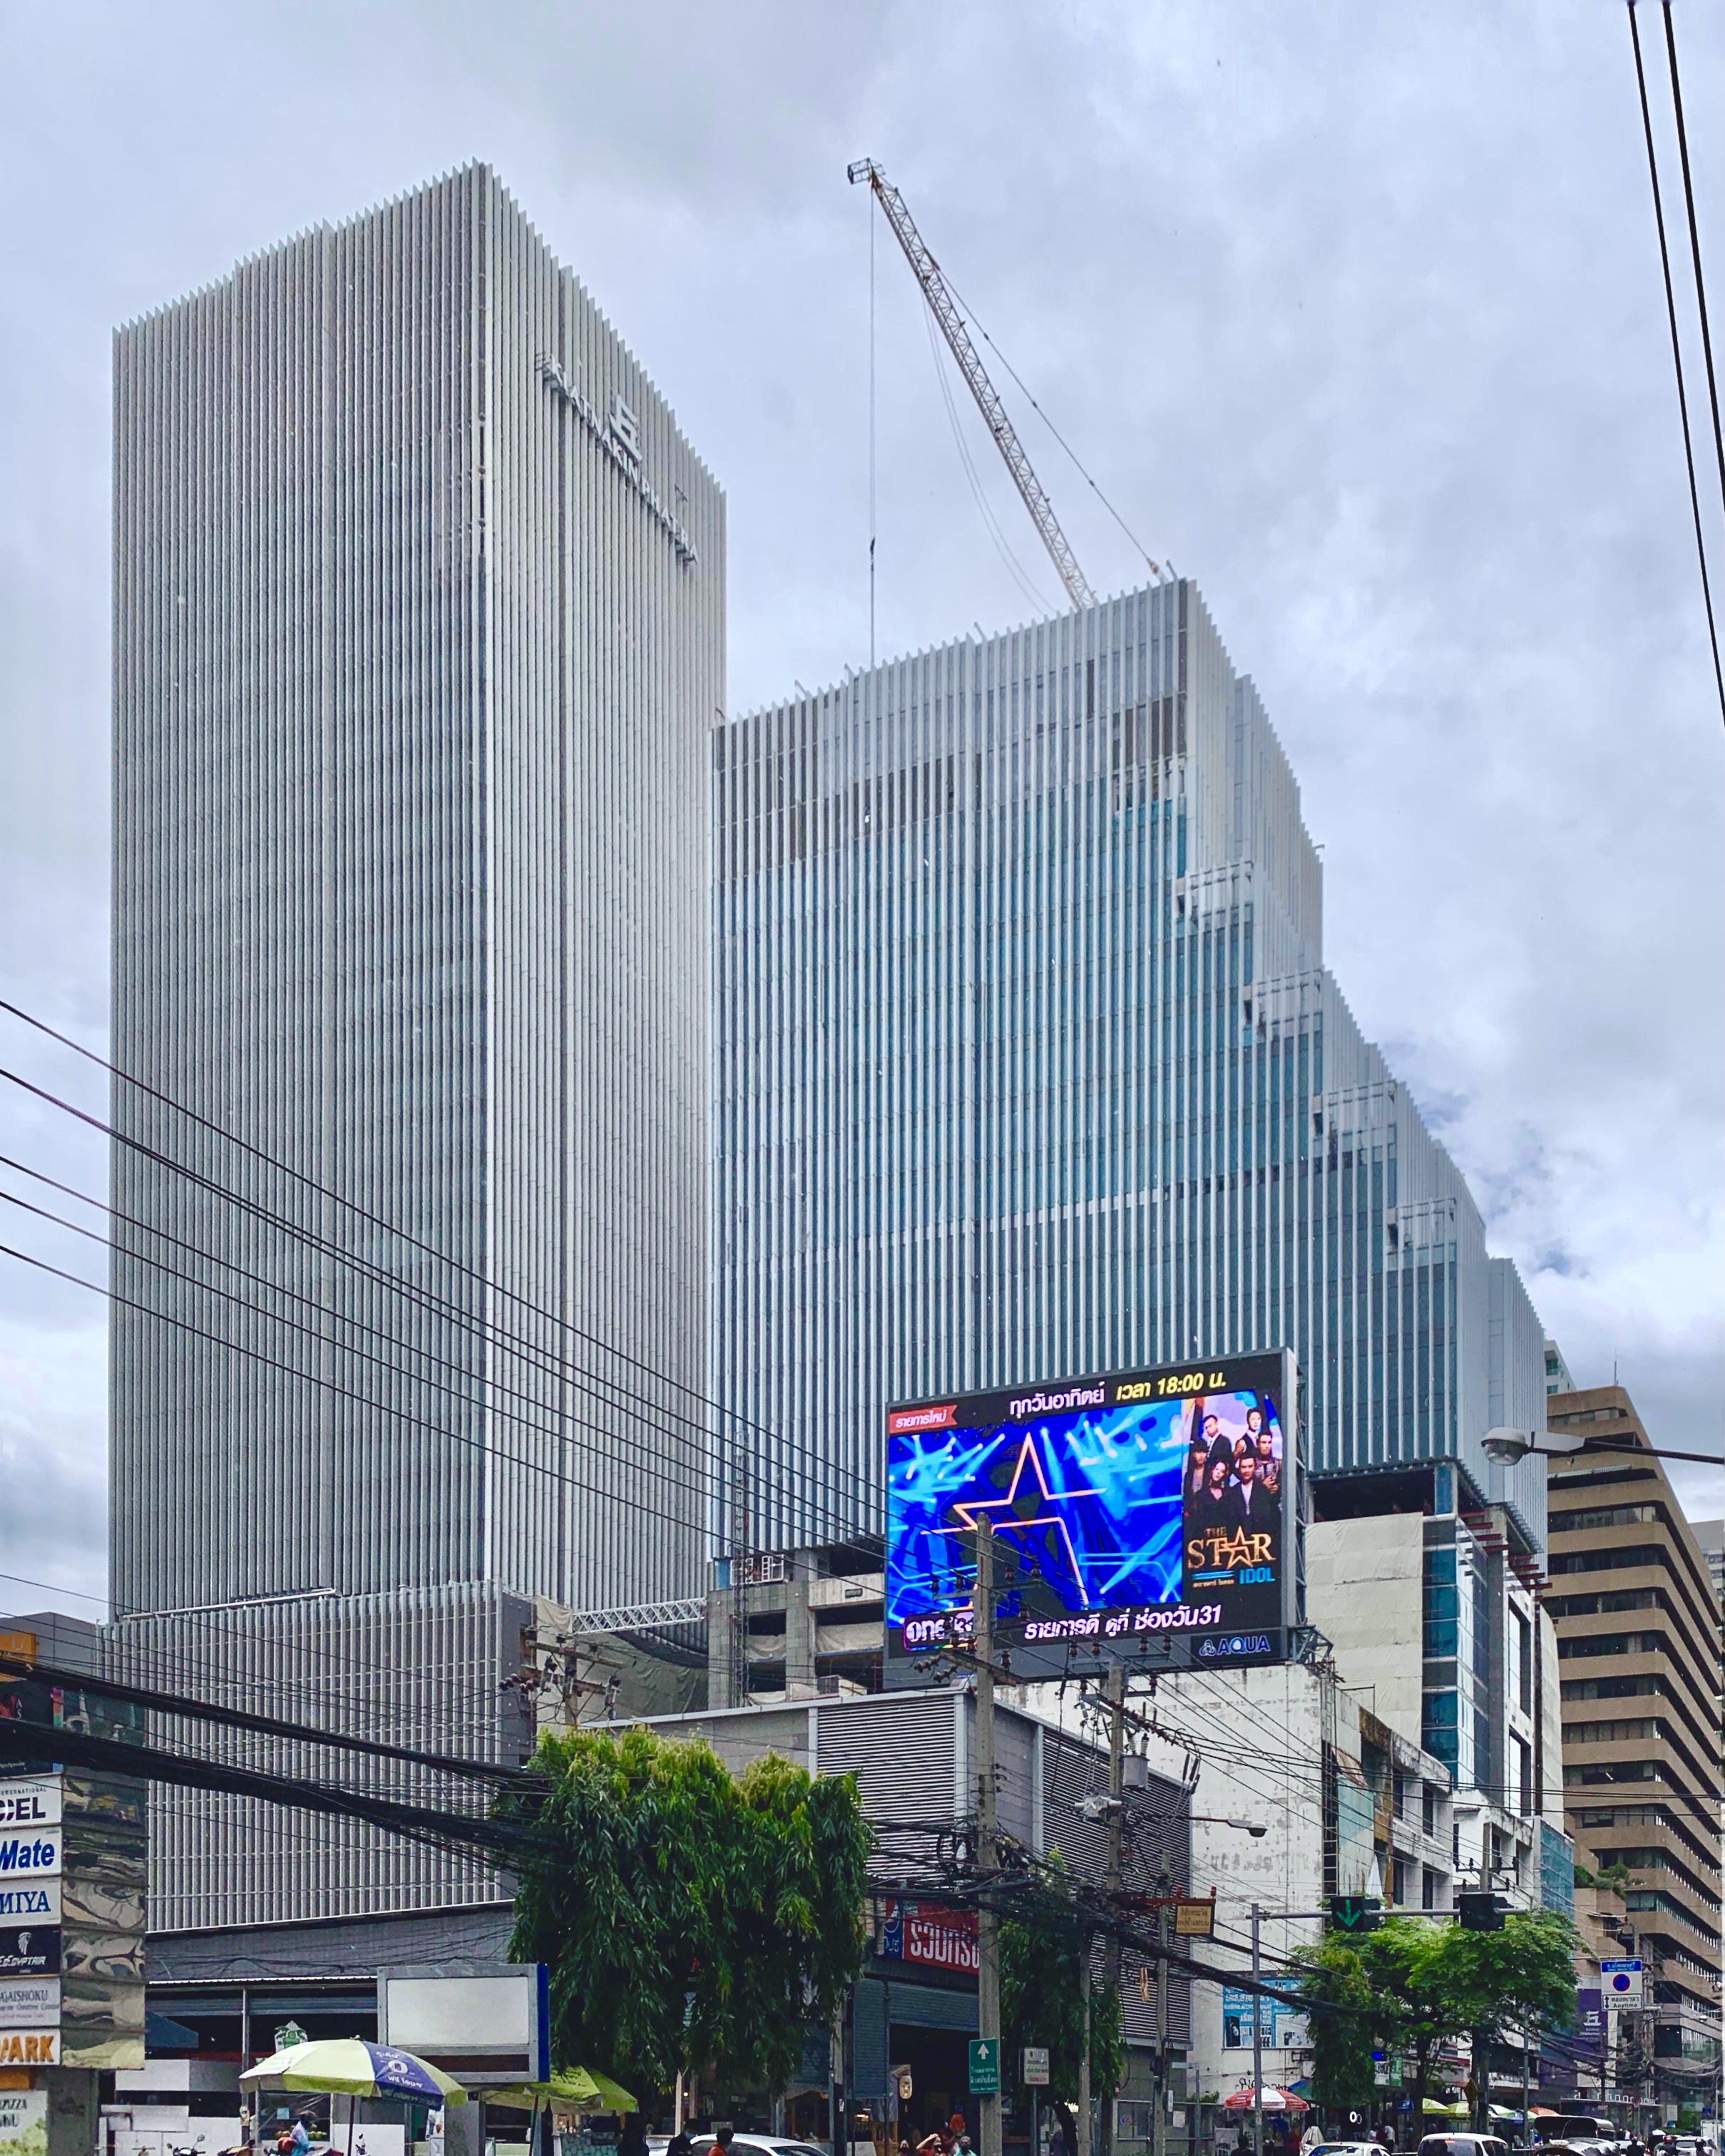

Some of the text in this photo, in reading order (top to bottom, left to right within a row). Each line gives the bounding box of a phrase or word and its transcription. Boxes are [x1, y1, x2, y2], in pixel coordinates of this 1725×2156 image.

[1010, 1372, 1227, 1419] ทุกวันอาทิตย์ เวลา 18:00 น.
[896, 1410, 946, 1428] รายการใหม่
[1205, 1527, 1227, 1537] THE
[1187, 1525, 1276, 1570] STAR
[1239, 1567, 1276, 1584] IDOL
[1217, 1636, 1271, 1655] AQUA
